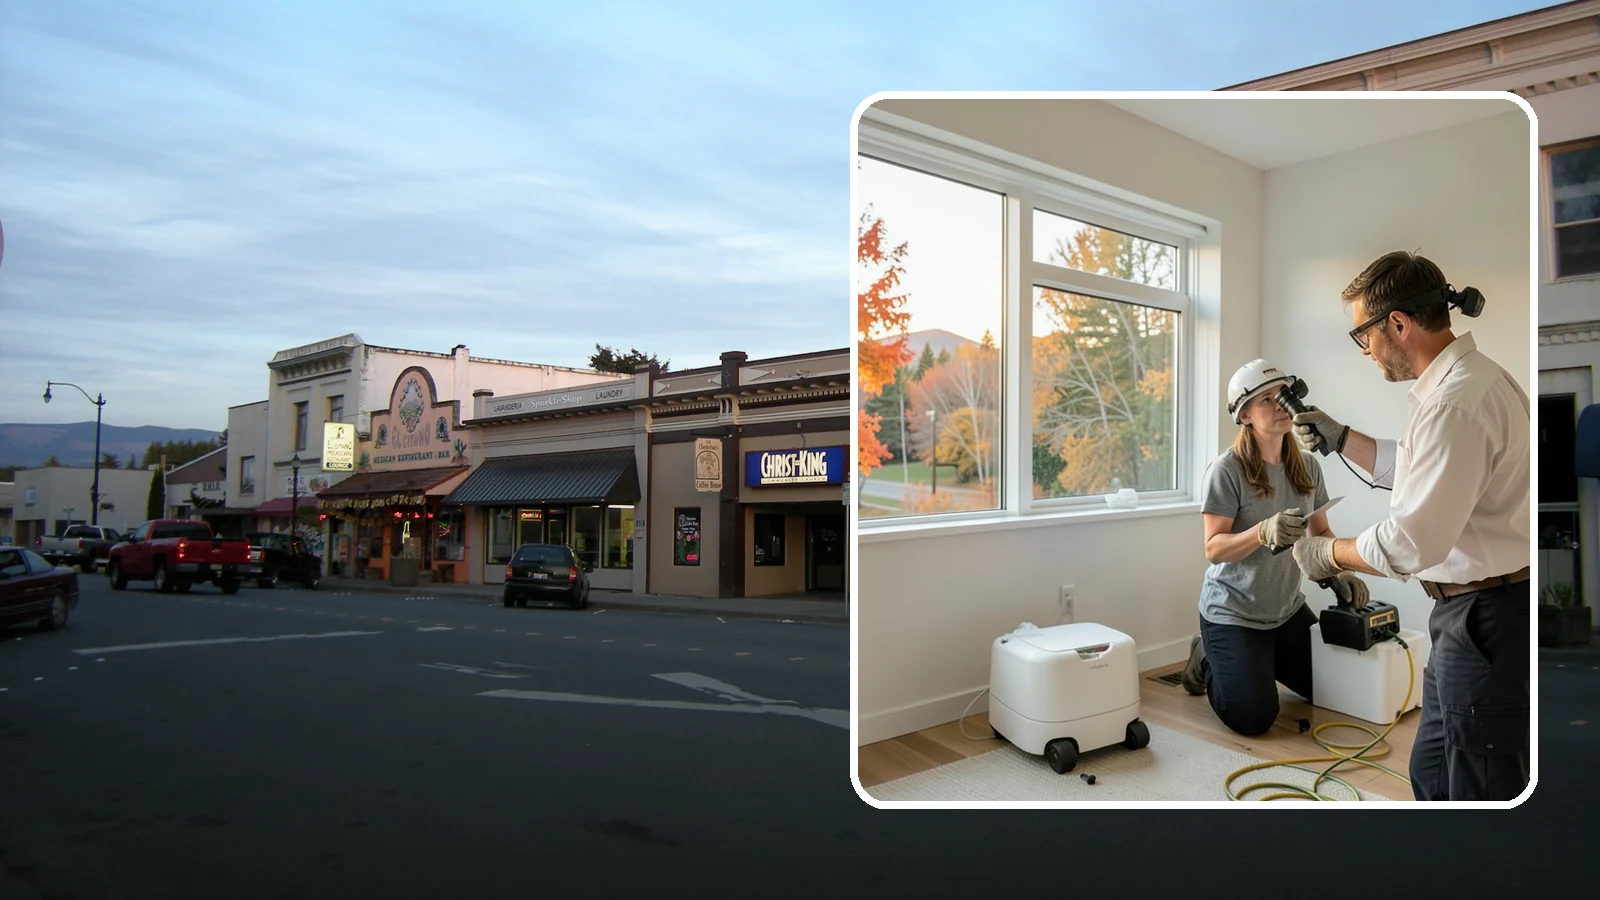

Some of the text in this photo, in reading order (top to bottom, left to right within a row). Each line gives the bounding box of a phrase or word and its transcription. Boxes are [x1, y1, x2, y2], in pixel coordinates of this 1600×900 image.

[561, 394, 583, 405] Shop
[595, 388, 624, 400] LAUNDRY
[493, 402, 522, 412] LAVANDERIA
[373, 454, 396, 464] MEXICAN
[397, 451, 433, 462] RESTAURANT
[437, 450, 450, 459] BAR
